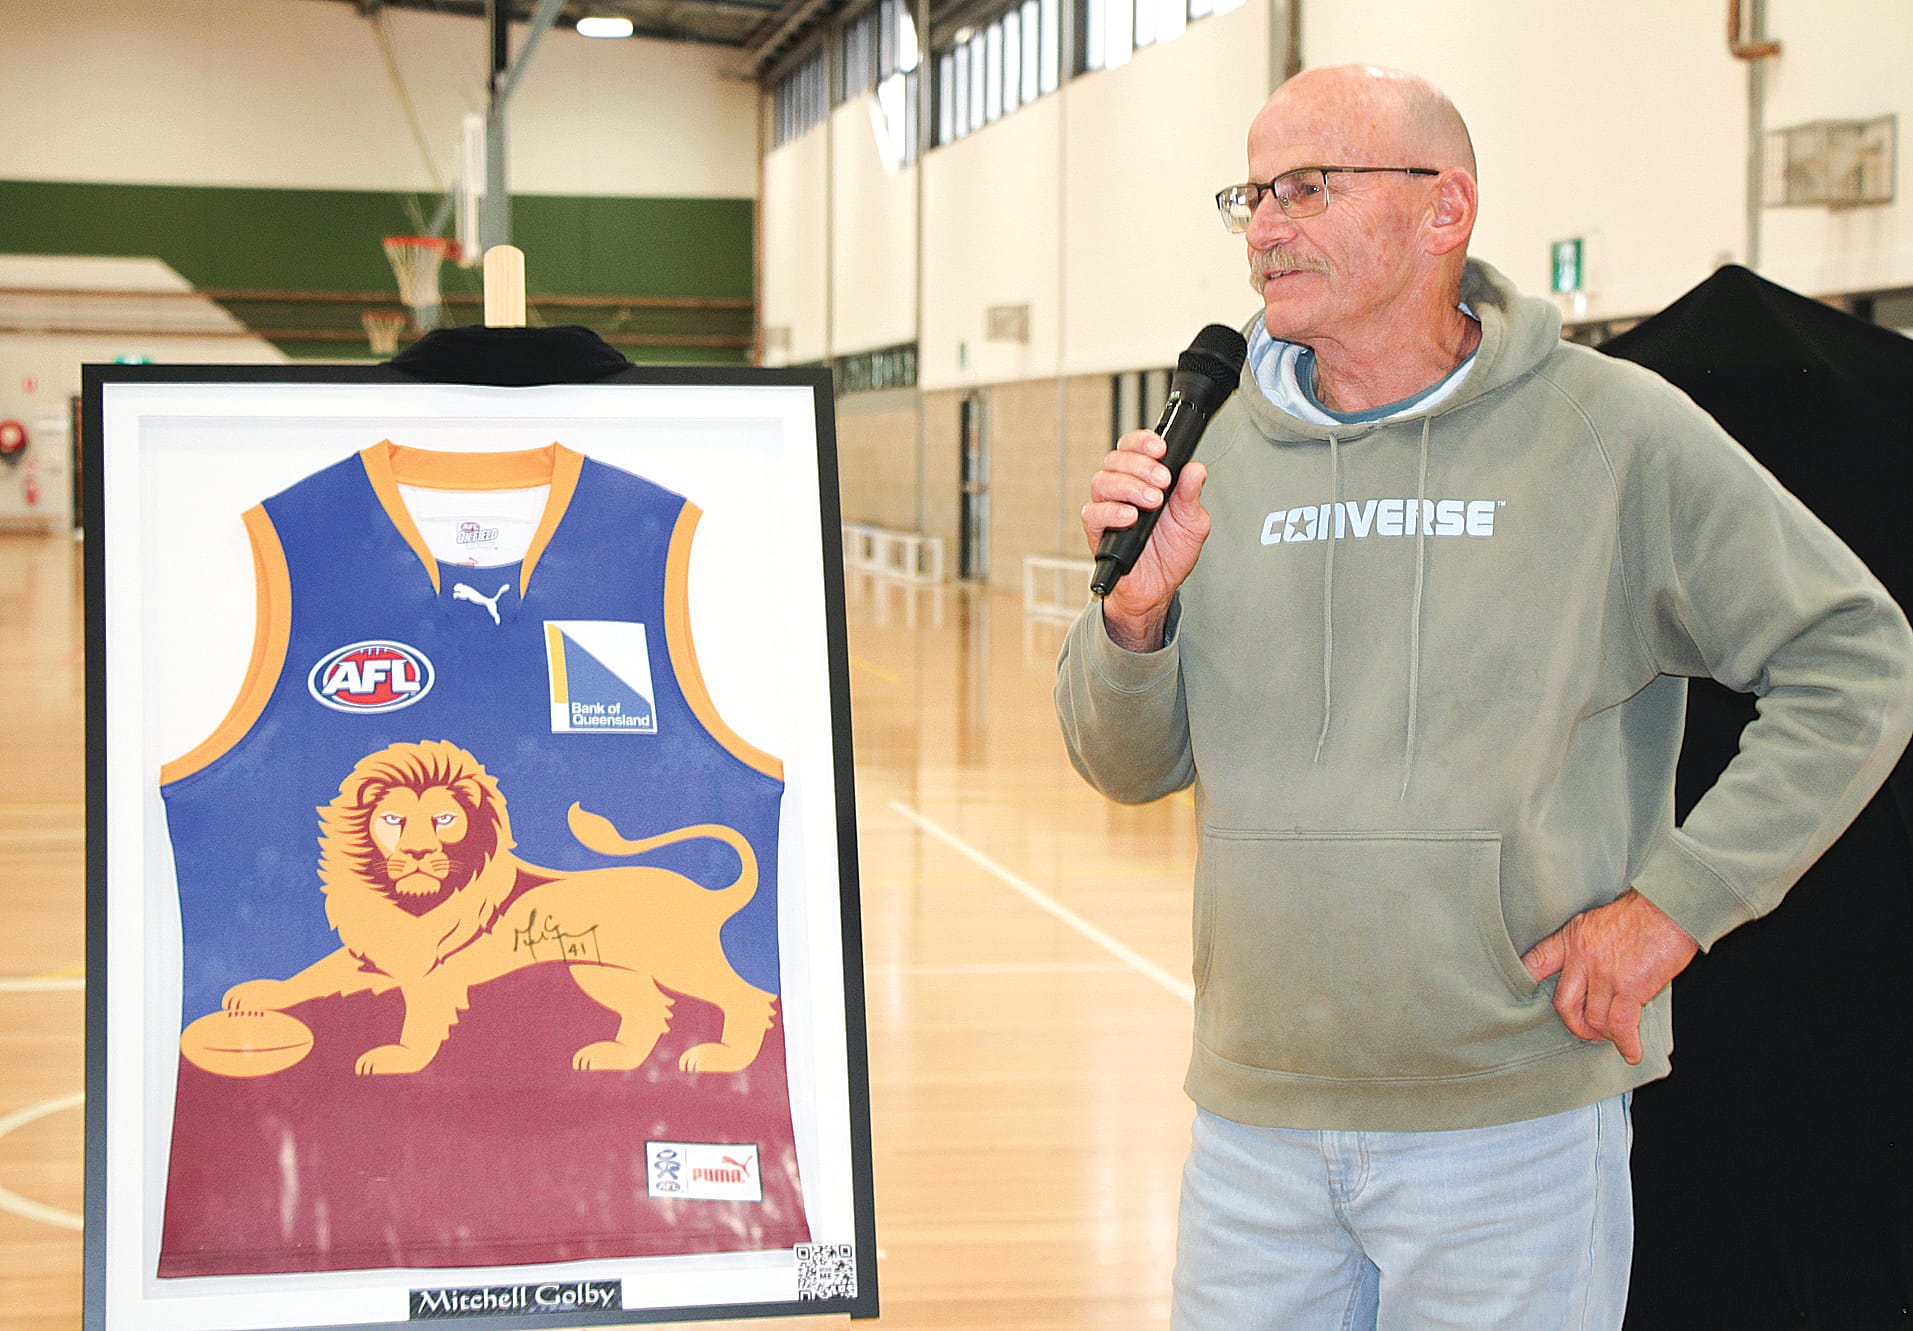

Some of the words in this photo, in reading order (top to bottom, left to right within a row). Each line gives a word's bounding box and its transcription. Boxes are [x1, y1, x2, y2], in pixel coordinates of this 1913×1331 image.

[1260, 499, 1496, 545] CONVERSE
[321, 659, 421, 695] AFL
[571, 702, 605, 714] Bank
[607, 702, 621, 714] of
[572, 713, 650, 727] Queensland
[418, 1285, 526, 1314] Mitchell
[534, 1282, 615, 1308] Golby
